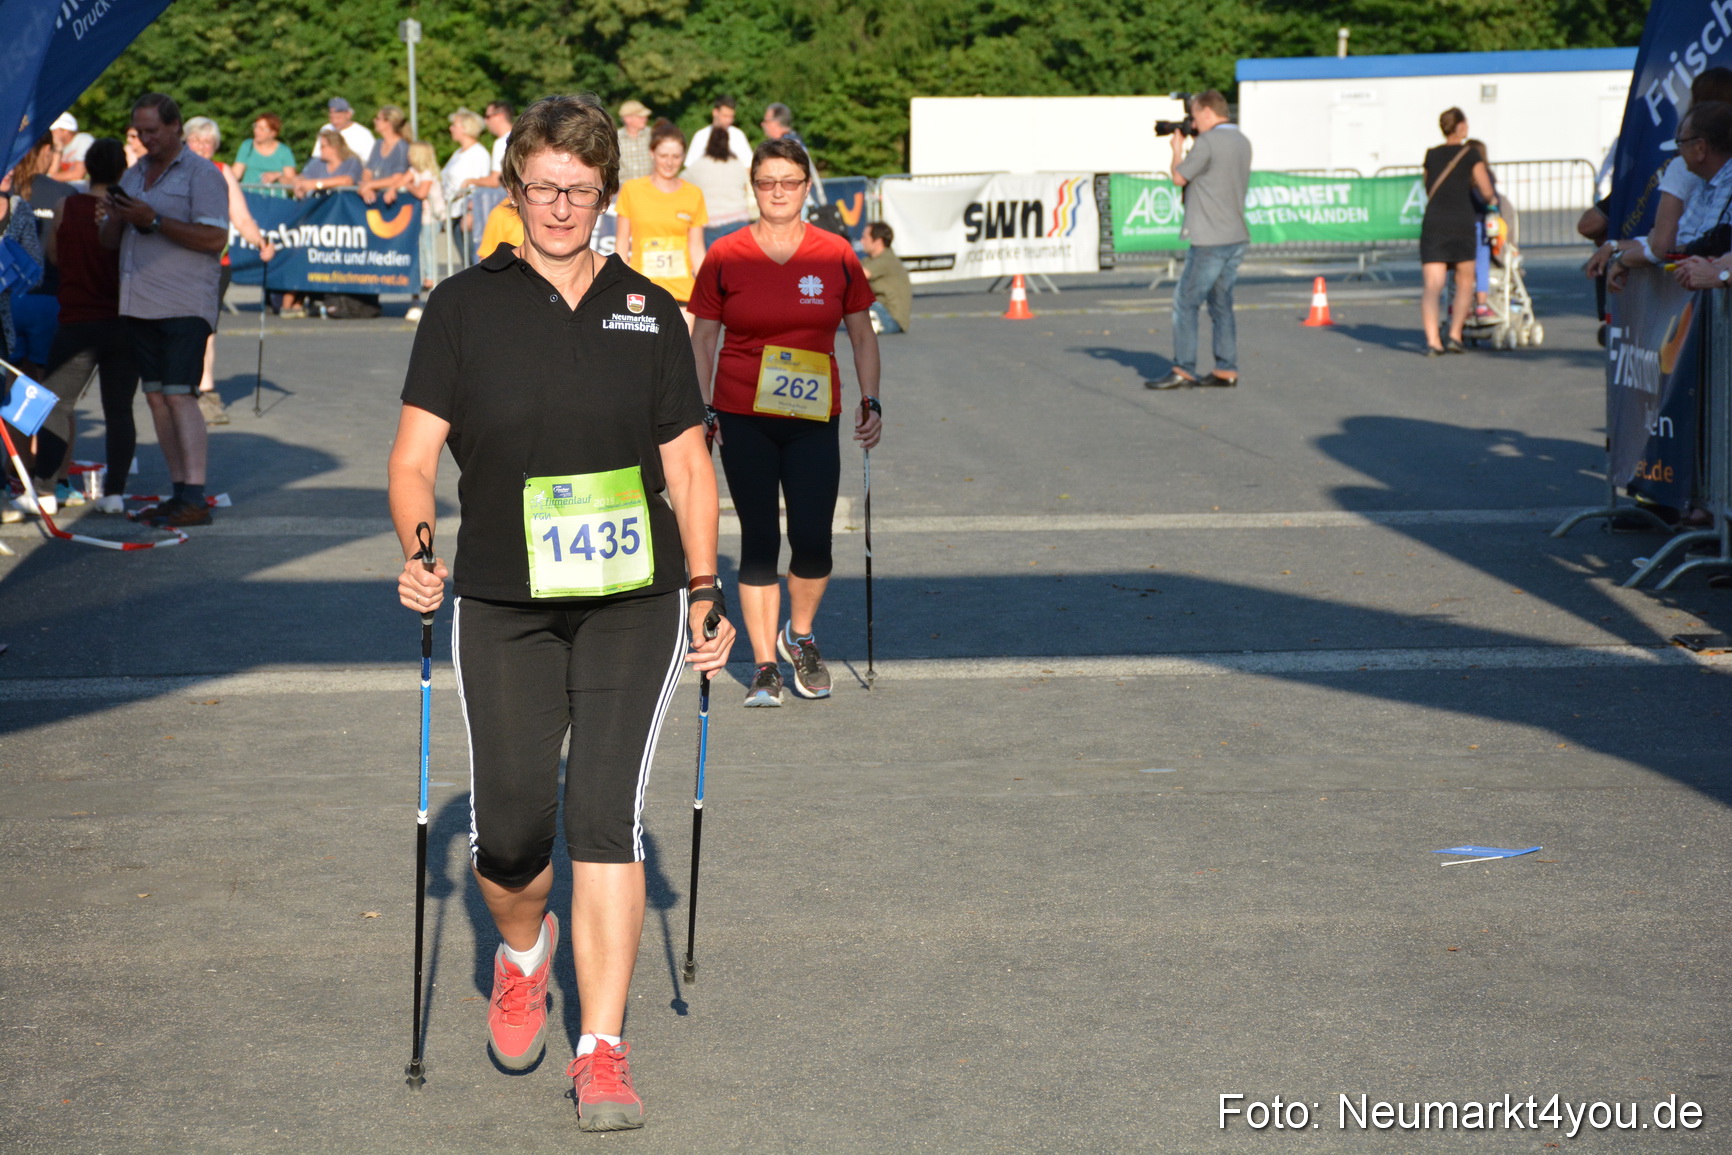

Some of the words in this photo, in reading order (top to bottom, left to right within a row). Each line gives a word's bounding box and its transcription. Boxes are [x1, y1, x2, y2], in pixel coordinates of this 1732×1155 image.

[963, 199, 1044, 242] swn
[228, 222, 368, 251] Fchmann
[656, 255, 673, 269] 51
[800, 297, 824, 305] caritas
[611, 313, 656, 323] Neumarkter
[773, 375, 819, 401] 262
[545, 494, 592, 506] firmenlauf
[542, 516, 640, 562] 1435
